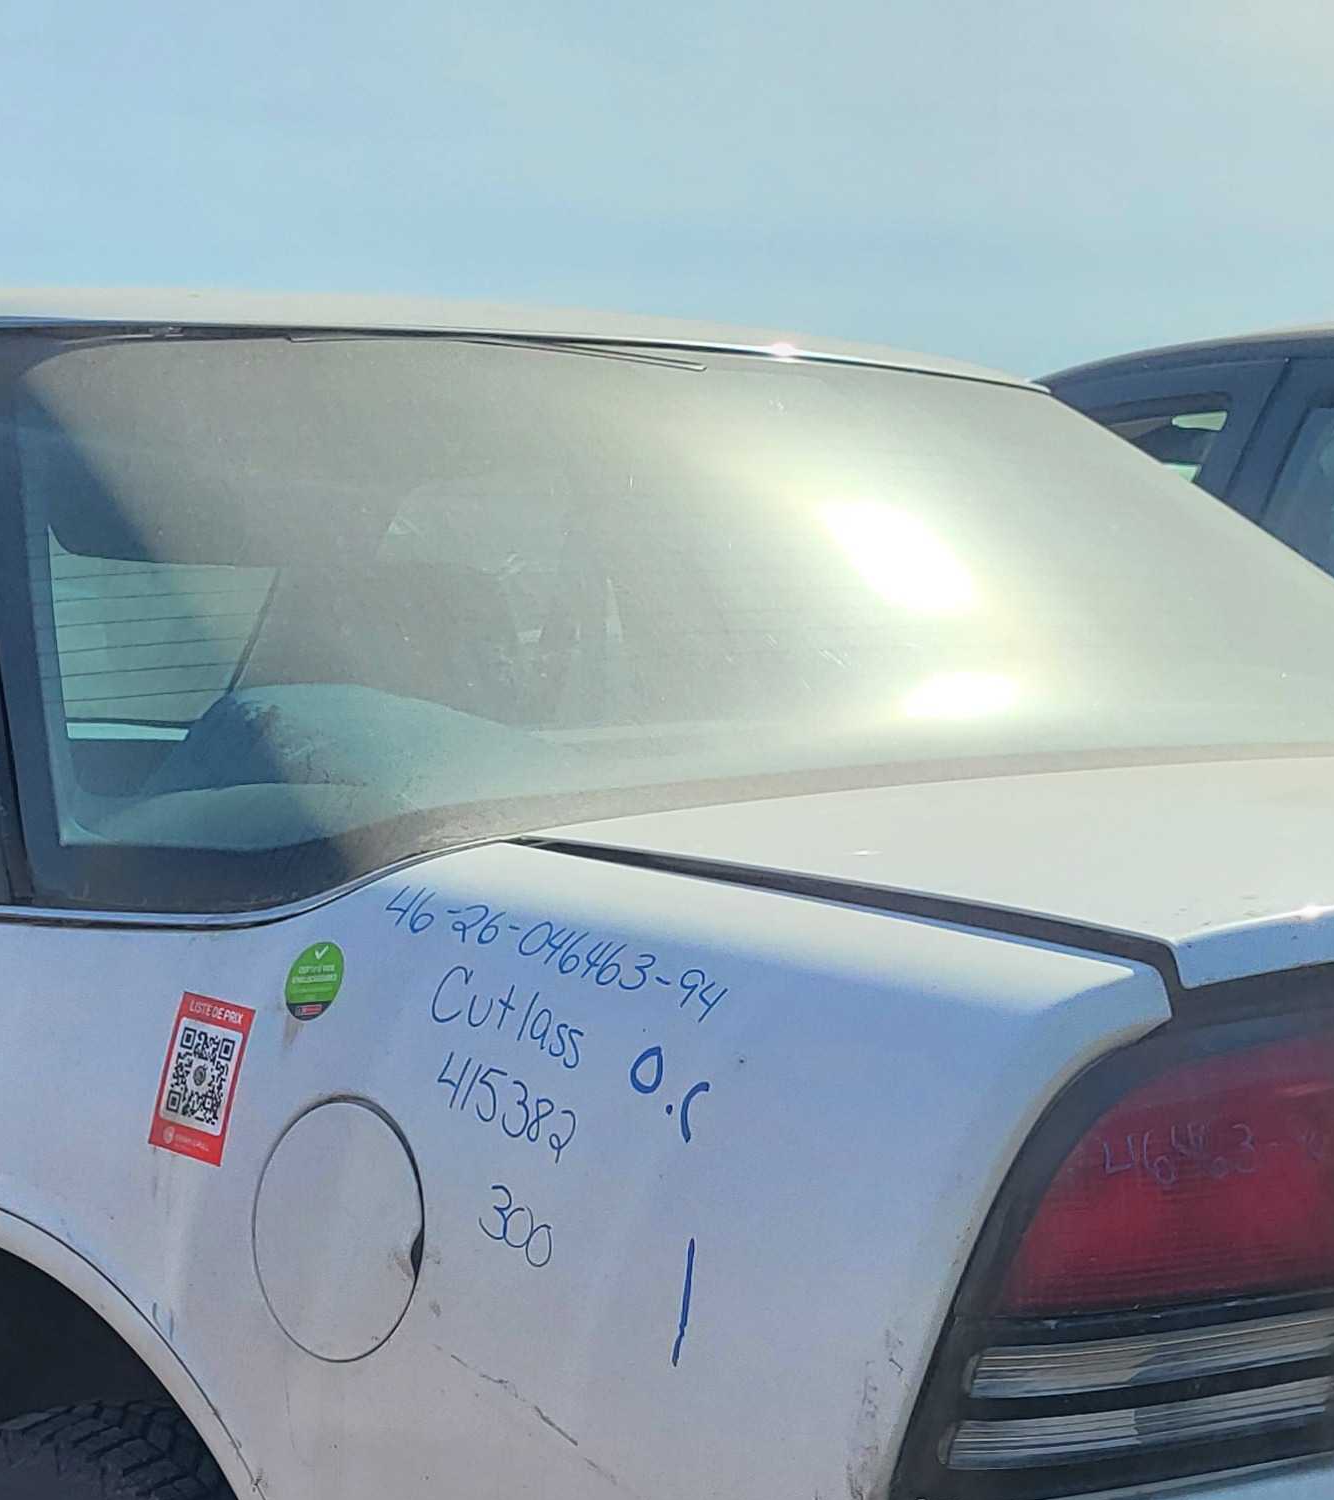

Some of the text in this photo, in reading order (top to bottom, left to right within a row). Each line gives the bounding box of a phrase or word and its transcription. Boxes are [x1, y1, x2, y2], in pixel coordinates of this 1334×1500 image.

[431, 965, 585, 1069] Cutlass
[436, 1051, 577, 1164] 415382
[478, 1184, 553, 1268] 300
